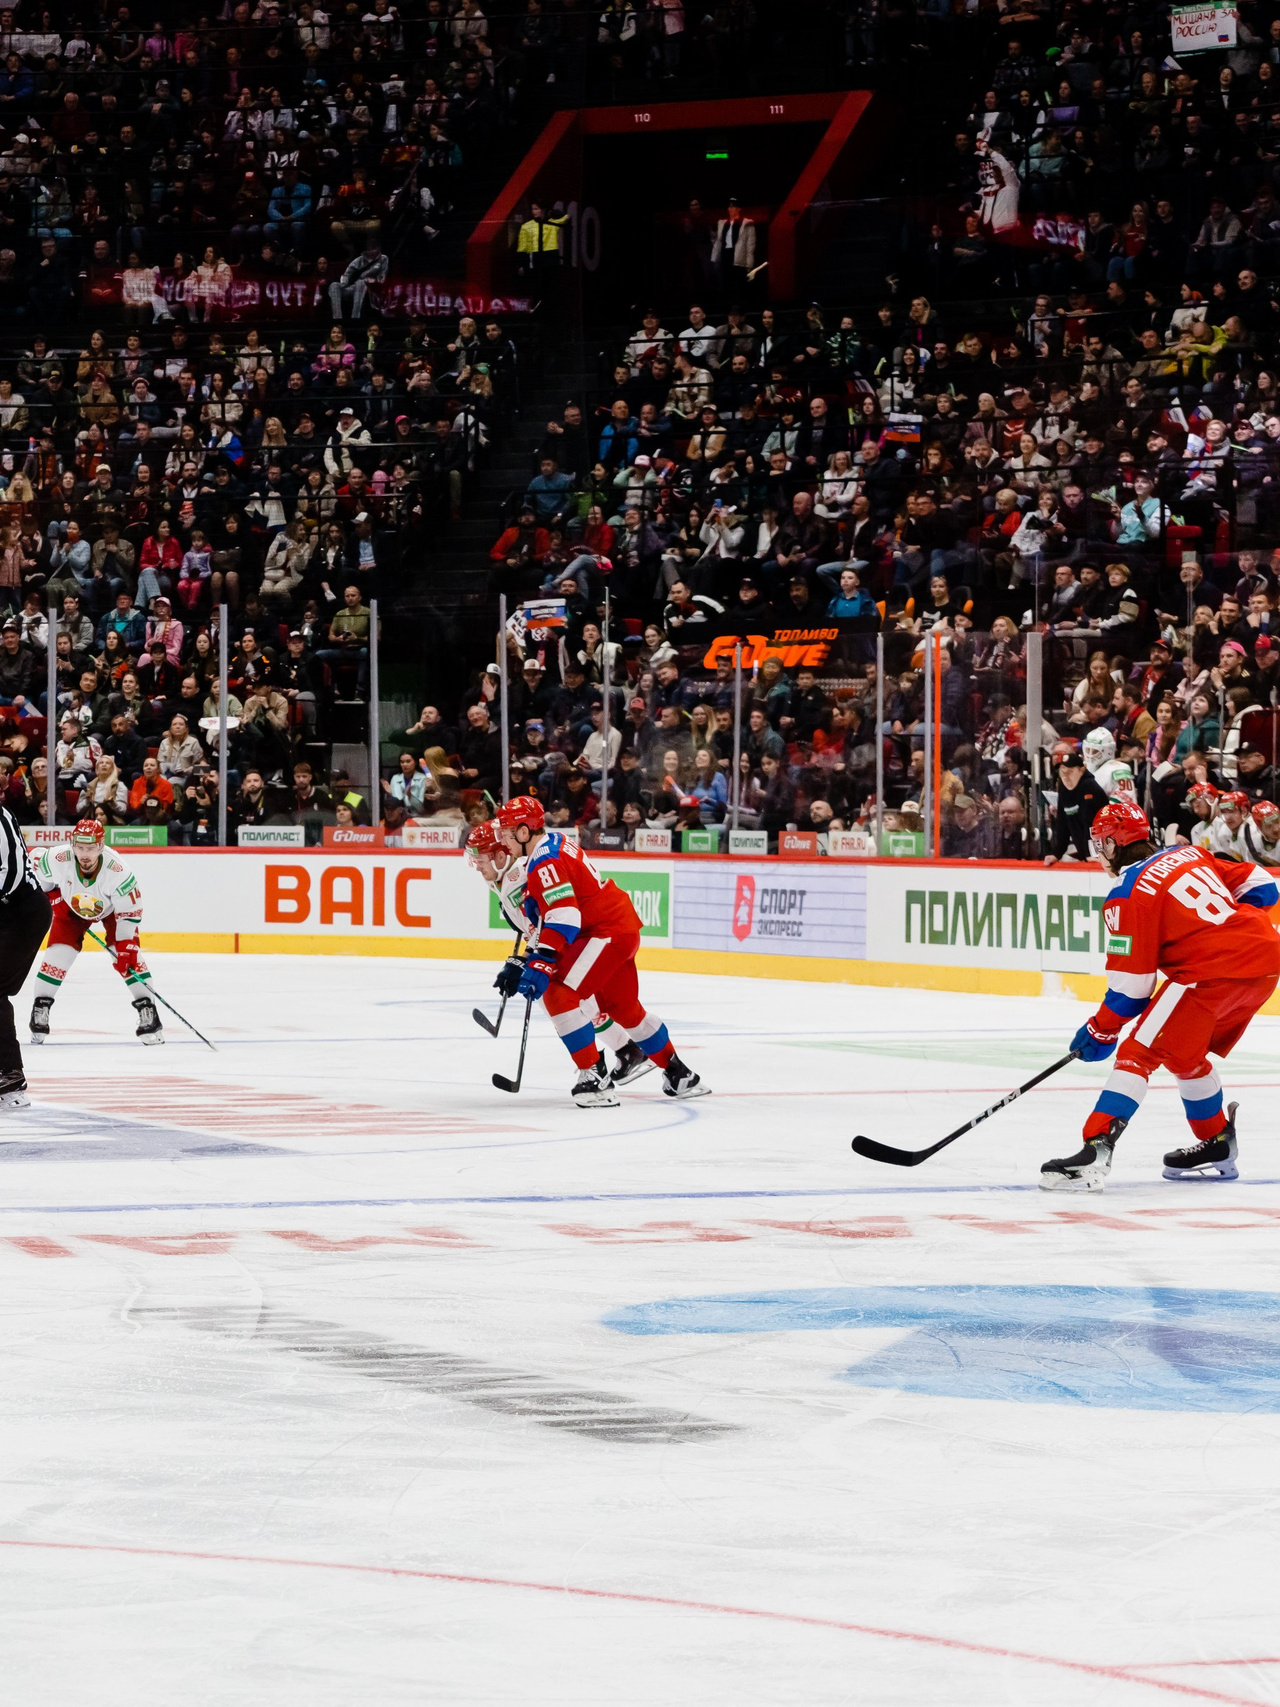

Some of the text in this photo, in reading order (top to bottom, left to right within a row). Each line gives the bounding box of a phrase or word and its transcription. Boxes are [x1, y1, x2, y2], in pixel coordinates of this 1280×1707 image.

[1176, 23, 1217, 38] РОССИЮ
[770, 105, 784, 115] 111
[634, 113, 651, 123] 110
[35, 831, 73, 841] FHR.R
[242, 831, 301, 842] ПОЛИПЛАСТ
[420, 831, 455, 844] FHR.RU
[646, 835, 669, 848] FHR.RU
[840, 836, 866, 850] FHR.RU
[537, 863, 560, 889] 81
[1136, 847, 1204, 897] VYDRENKOV
[264, 864, 432, 928] BAIC
[759, 888, 807, 916] СПОРТ
[757, 919, 804, 937] ЭКСПРЕСС
[905, 889, 1106, 954] ПОЛИПЛАСТ
[970, 1088, 1021, 1128] CCM
